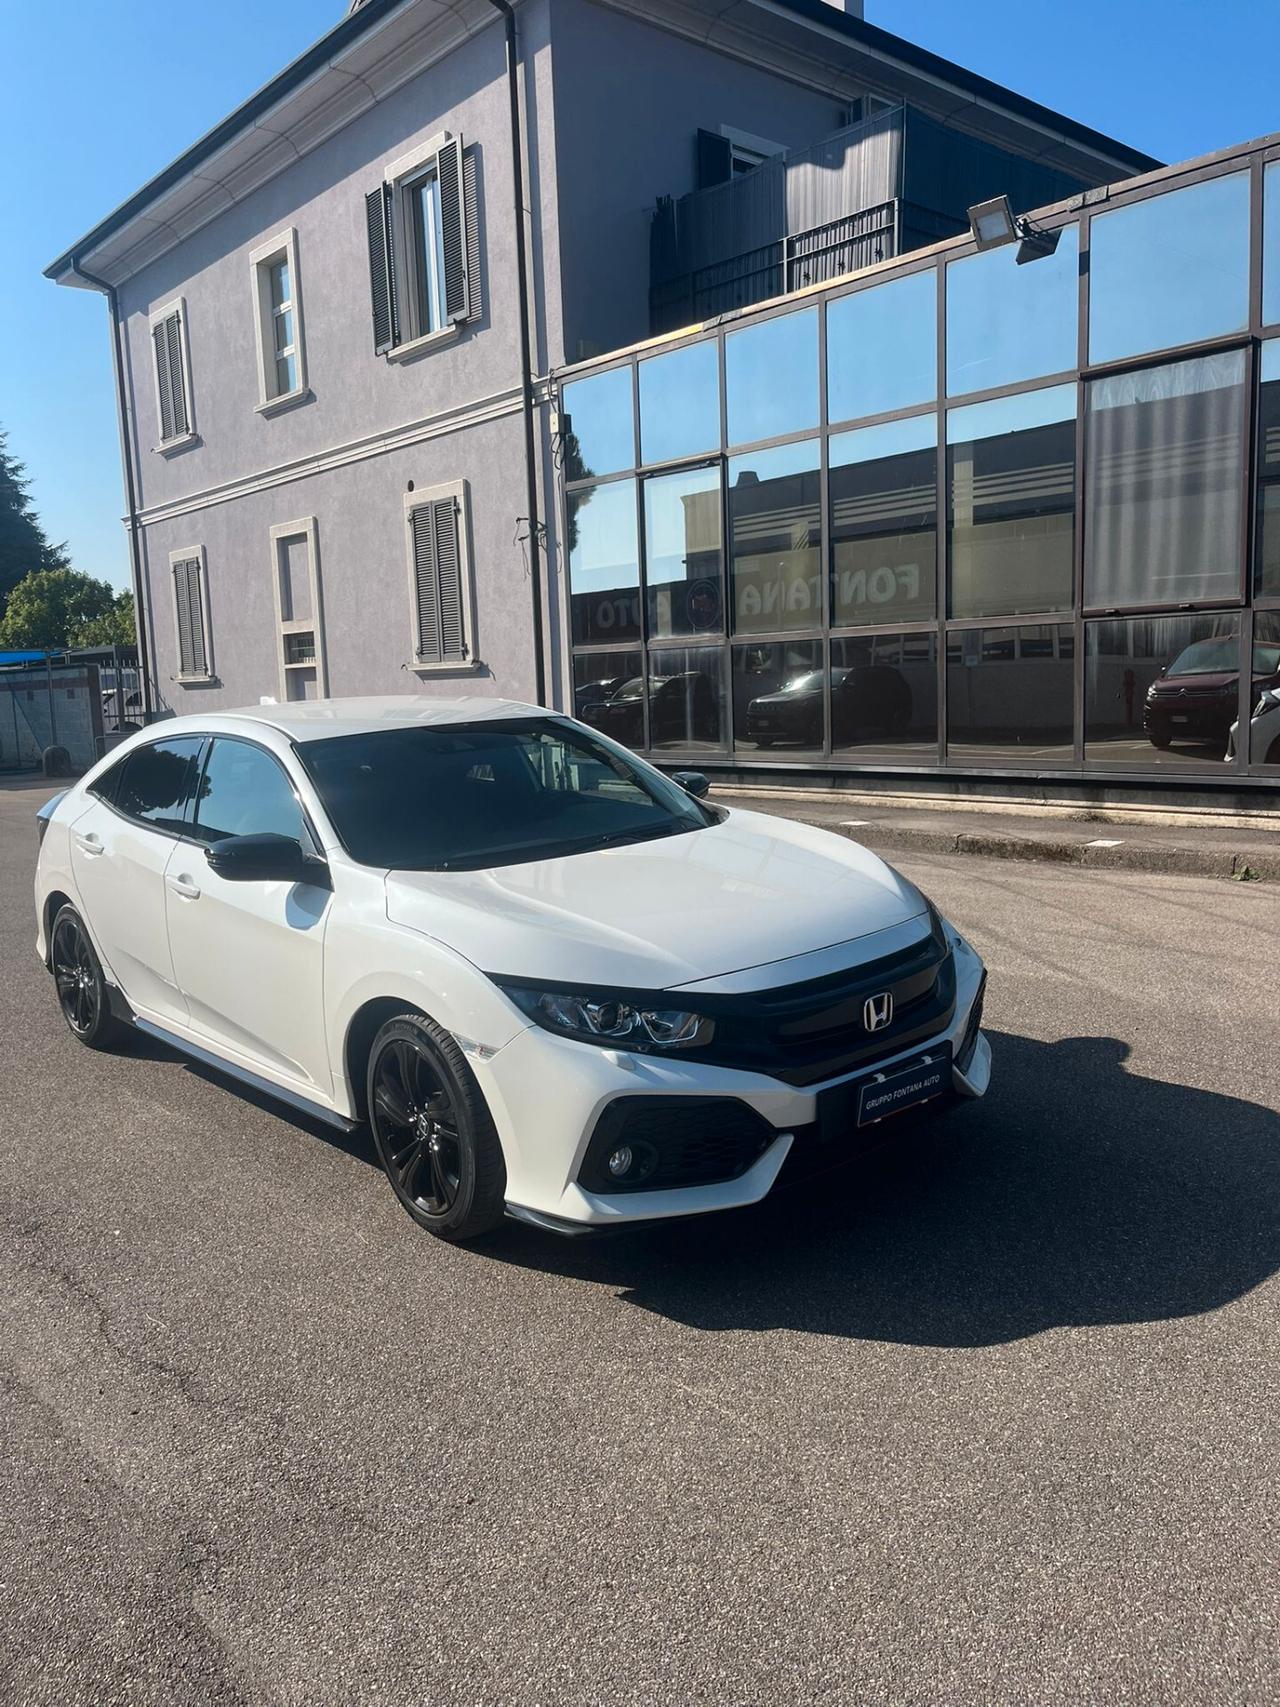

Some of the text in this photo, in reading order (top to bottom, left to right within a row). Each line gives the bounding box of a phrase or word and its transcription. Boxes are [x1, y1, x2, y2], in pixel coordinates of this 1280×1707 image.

[866, 1074, 941, 1110] GRUPPO FONTANA AUTO
